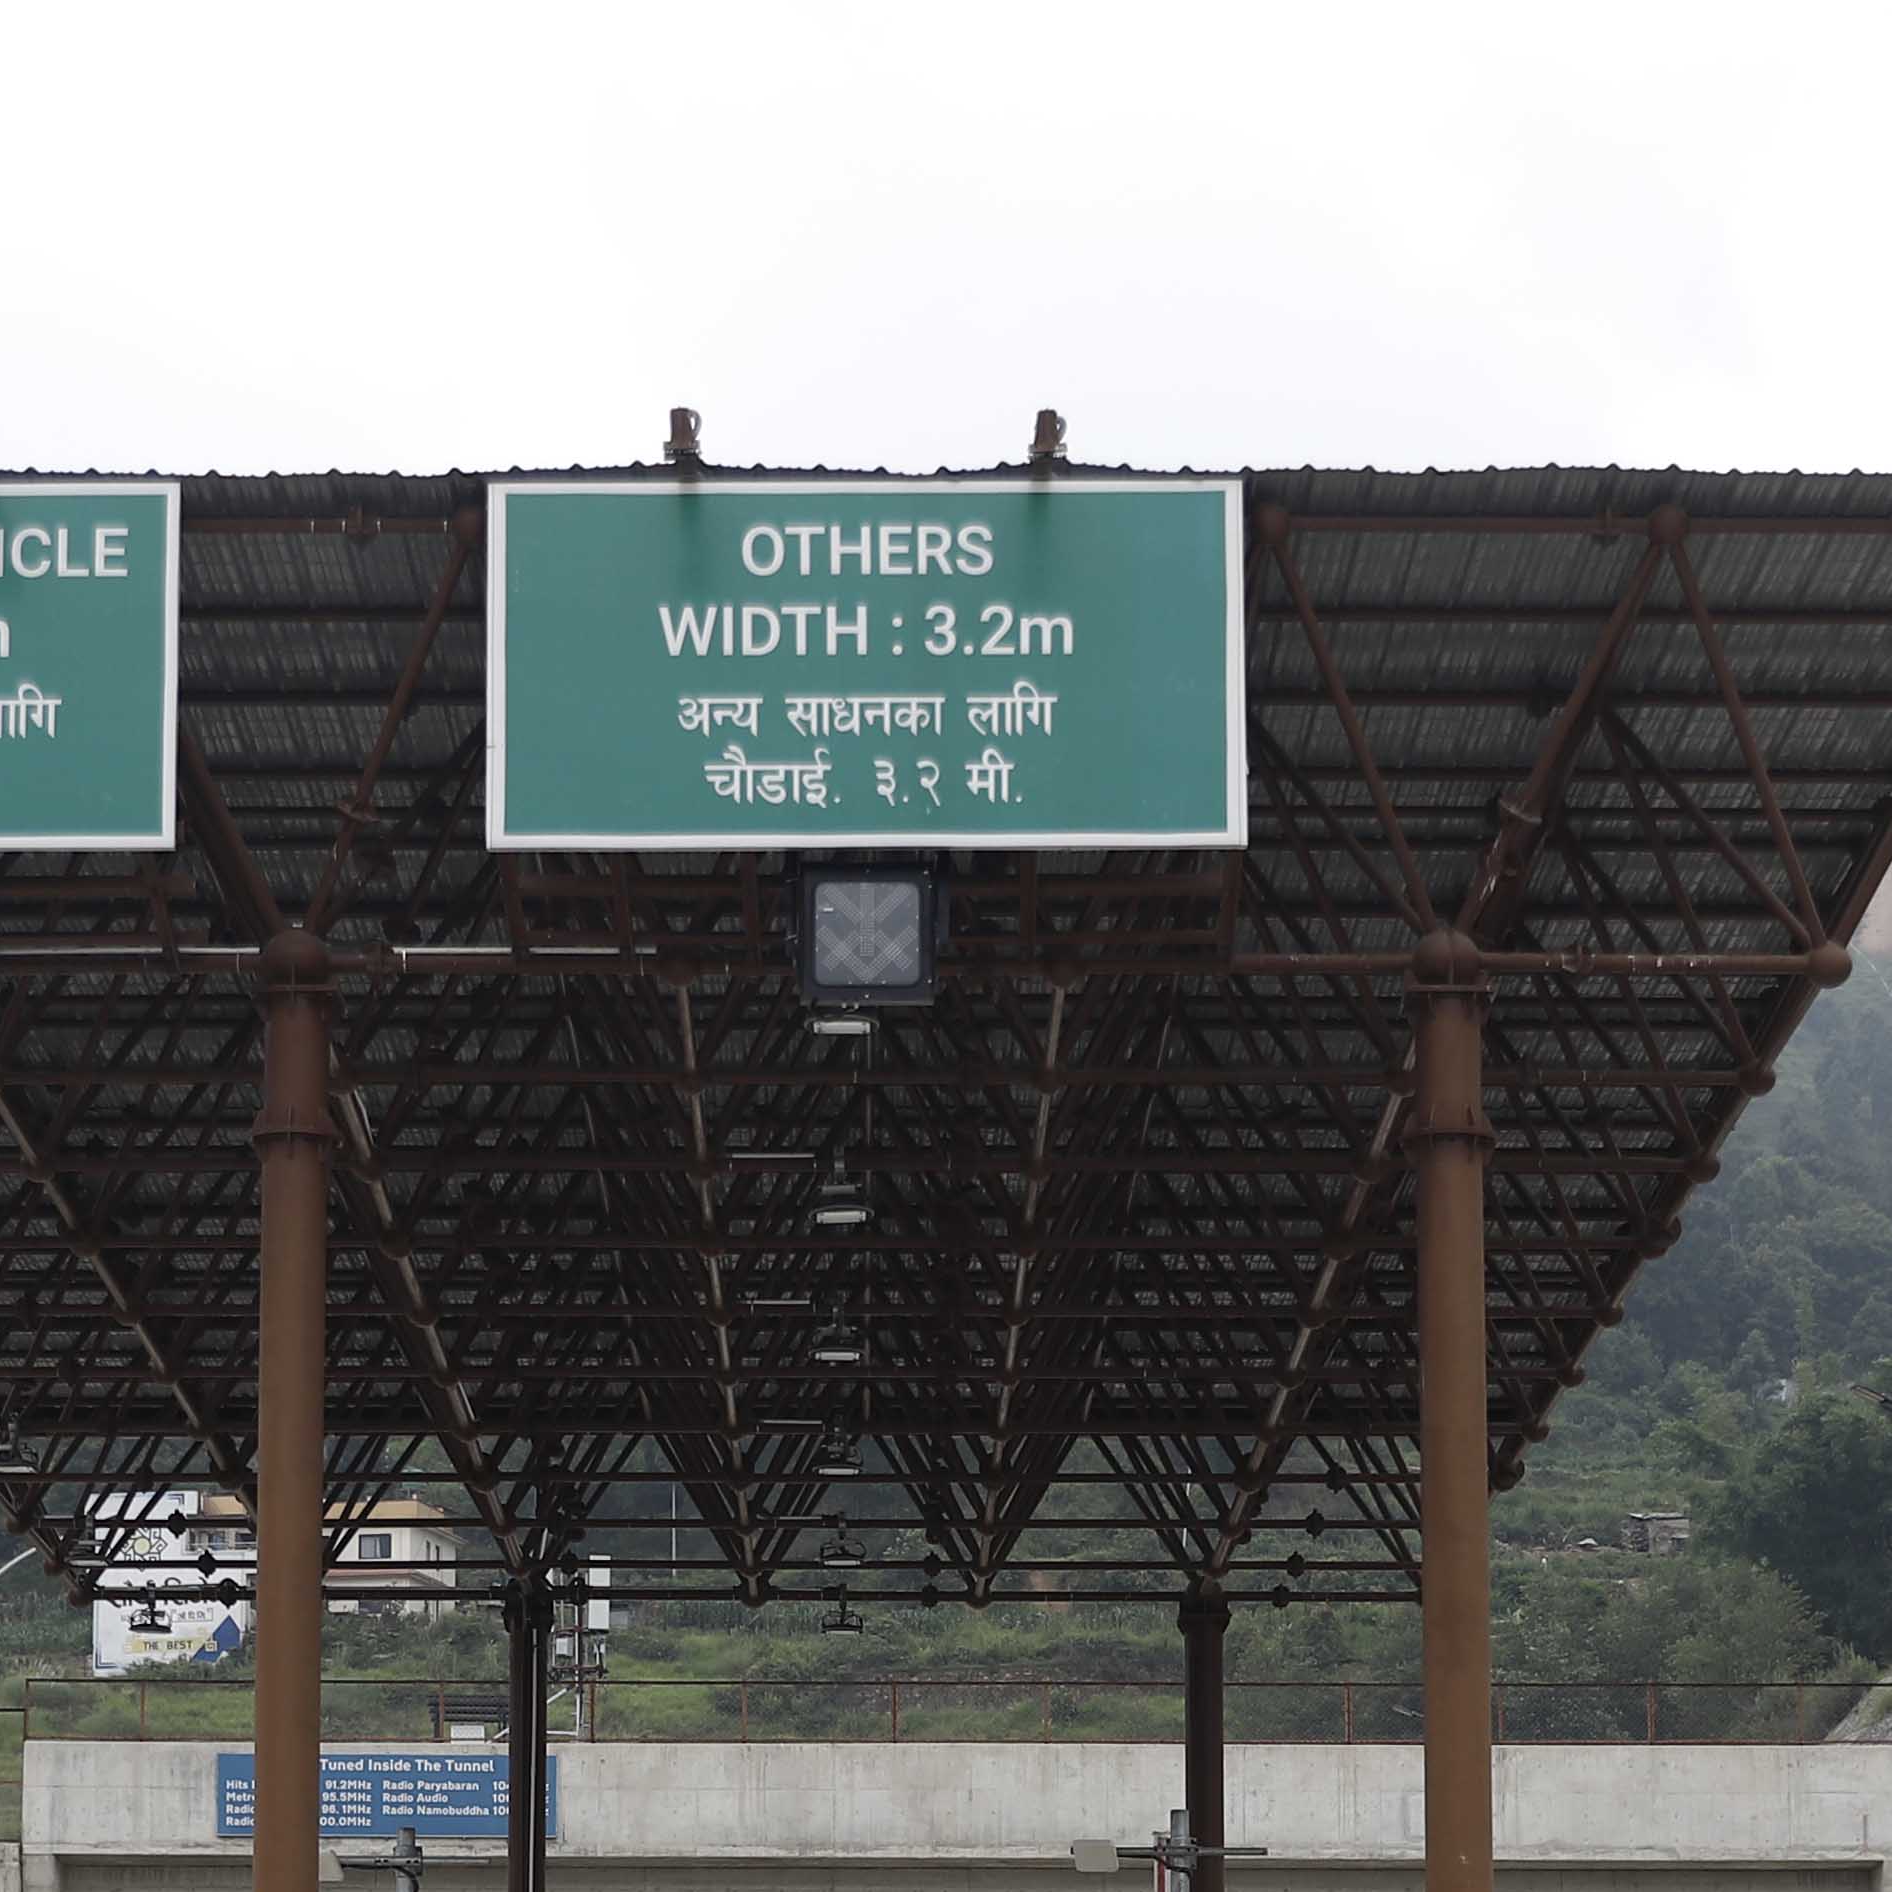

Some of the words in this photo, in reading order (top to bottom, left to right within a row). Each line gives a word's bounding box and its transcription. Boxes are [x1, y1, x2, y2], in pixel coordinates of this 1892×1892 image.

[741, 523, 994, 577] OTHERS
[659, 604, 868, 657] WIDTH
[924, 603, 1074, 656] 3.2m
[677, 694, 763, 738] अन्य
[784, 695, 946, 738] साधनका
[965, 679, 1059, 738] लागि
[142, 1640, 160, 1651] THE
[166, 1639, 193, 1650] BEST
[319, 1758, 364, 1772] Tuned
[368, 1758, 412, 1772] Inside
[414, 1759, 442, 1772] The
[445, 1758, 495, 1772] Tunnel
[226, 1780, 249, 1791] Hits
[382, 1780, 414, 1791] Radio
[417, 1780, 479, 1794] Paryabaran
[382, 1792, 414, 1803] Radio
[417, 1792, 449, 1803] Audio
[382, 1804, 414, 1815] Radio
[417, 1804, 490, 1816] Namobuddha
